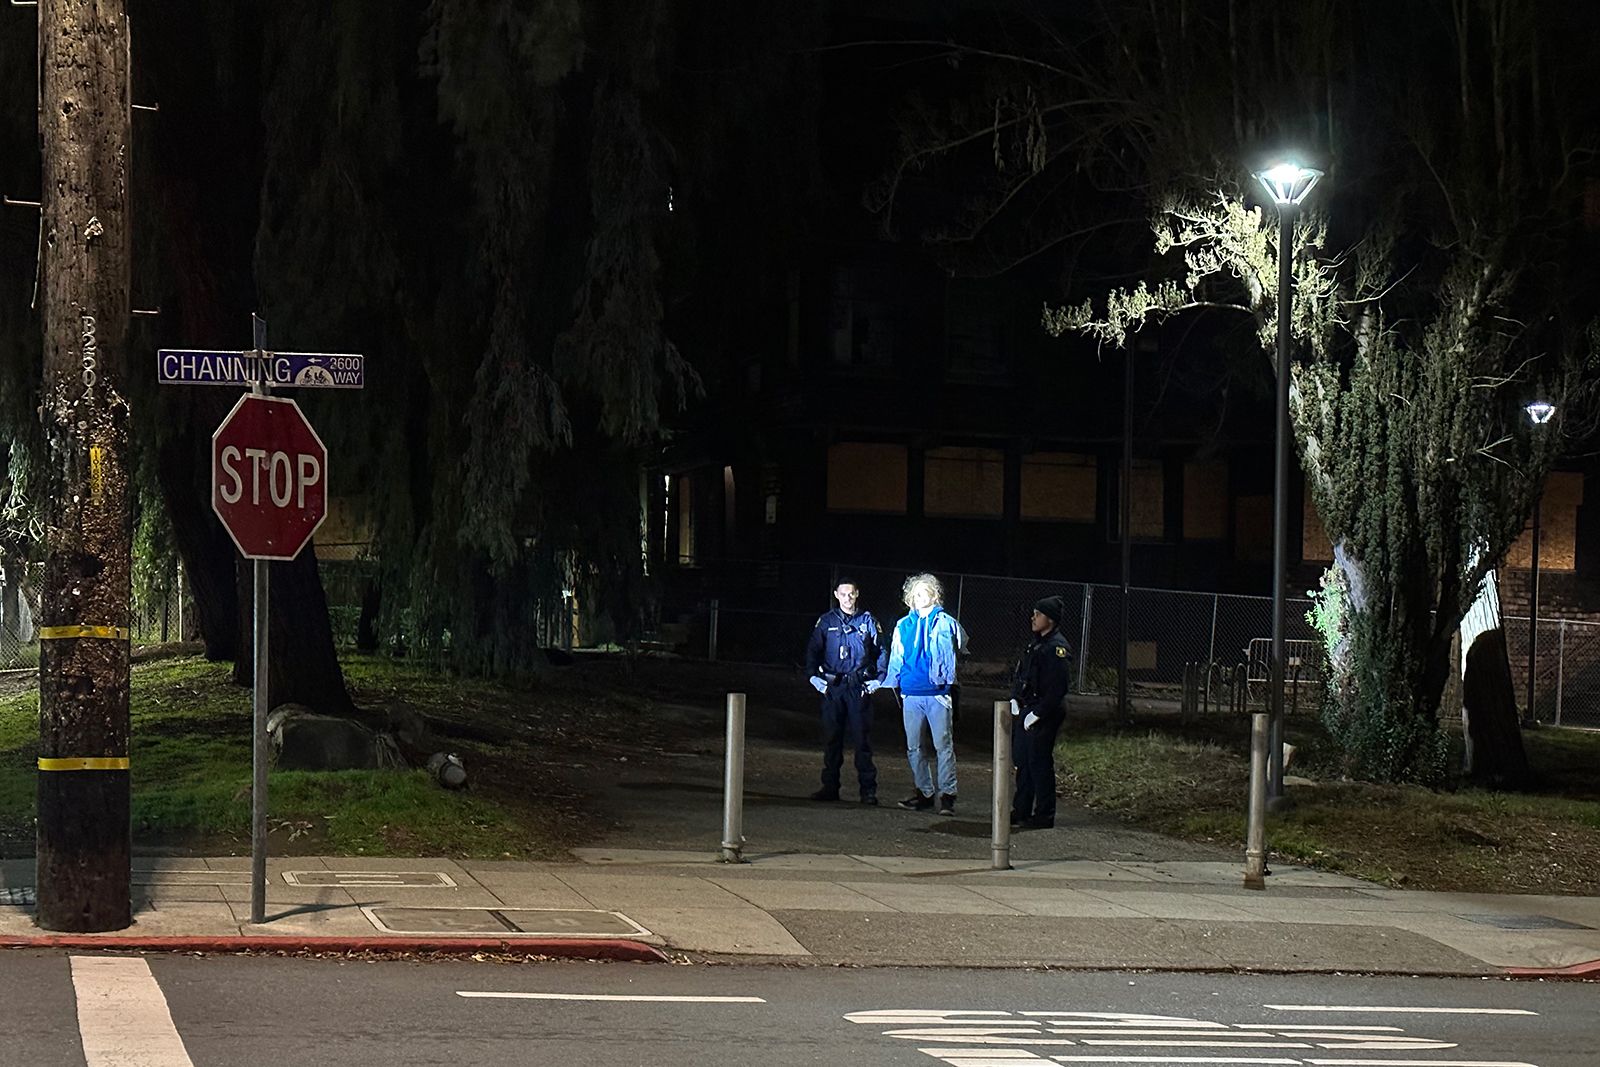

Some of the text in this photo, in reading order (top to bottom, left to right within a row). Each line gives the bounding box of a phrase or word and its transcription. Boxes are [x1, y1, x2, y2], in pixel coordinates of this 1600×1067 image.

[163, 355, 291, 382] CHANNING
[329, 357, 360, 371] 2600
[334, 371, 360, 384] WAY
[220, 445, 320, 509] STOP
